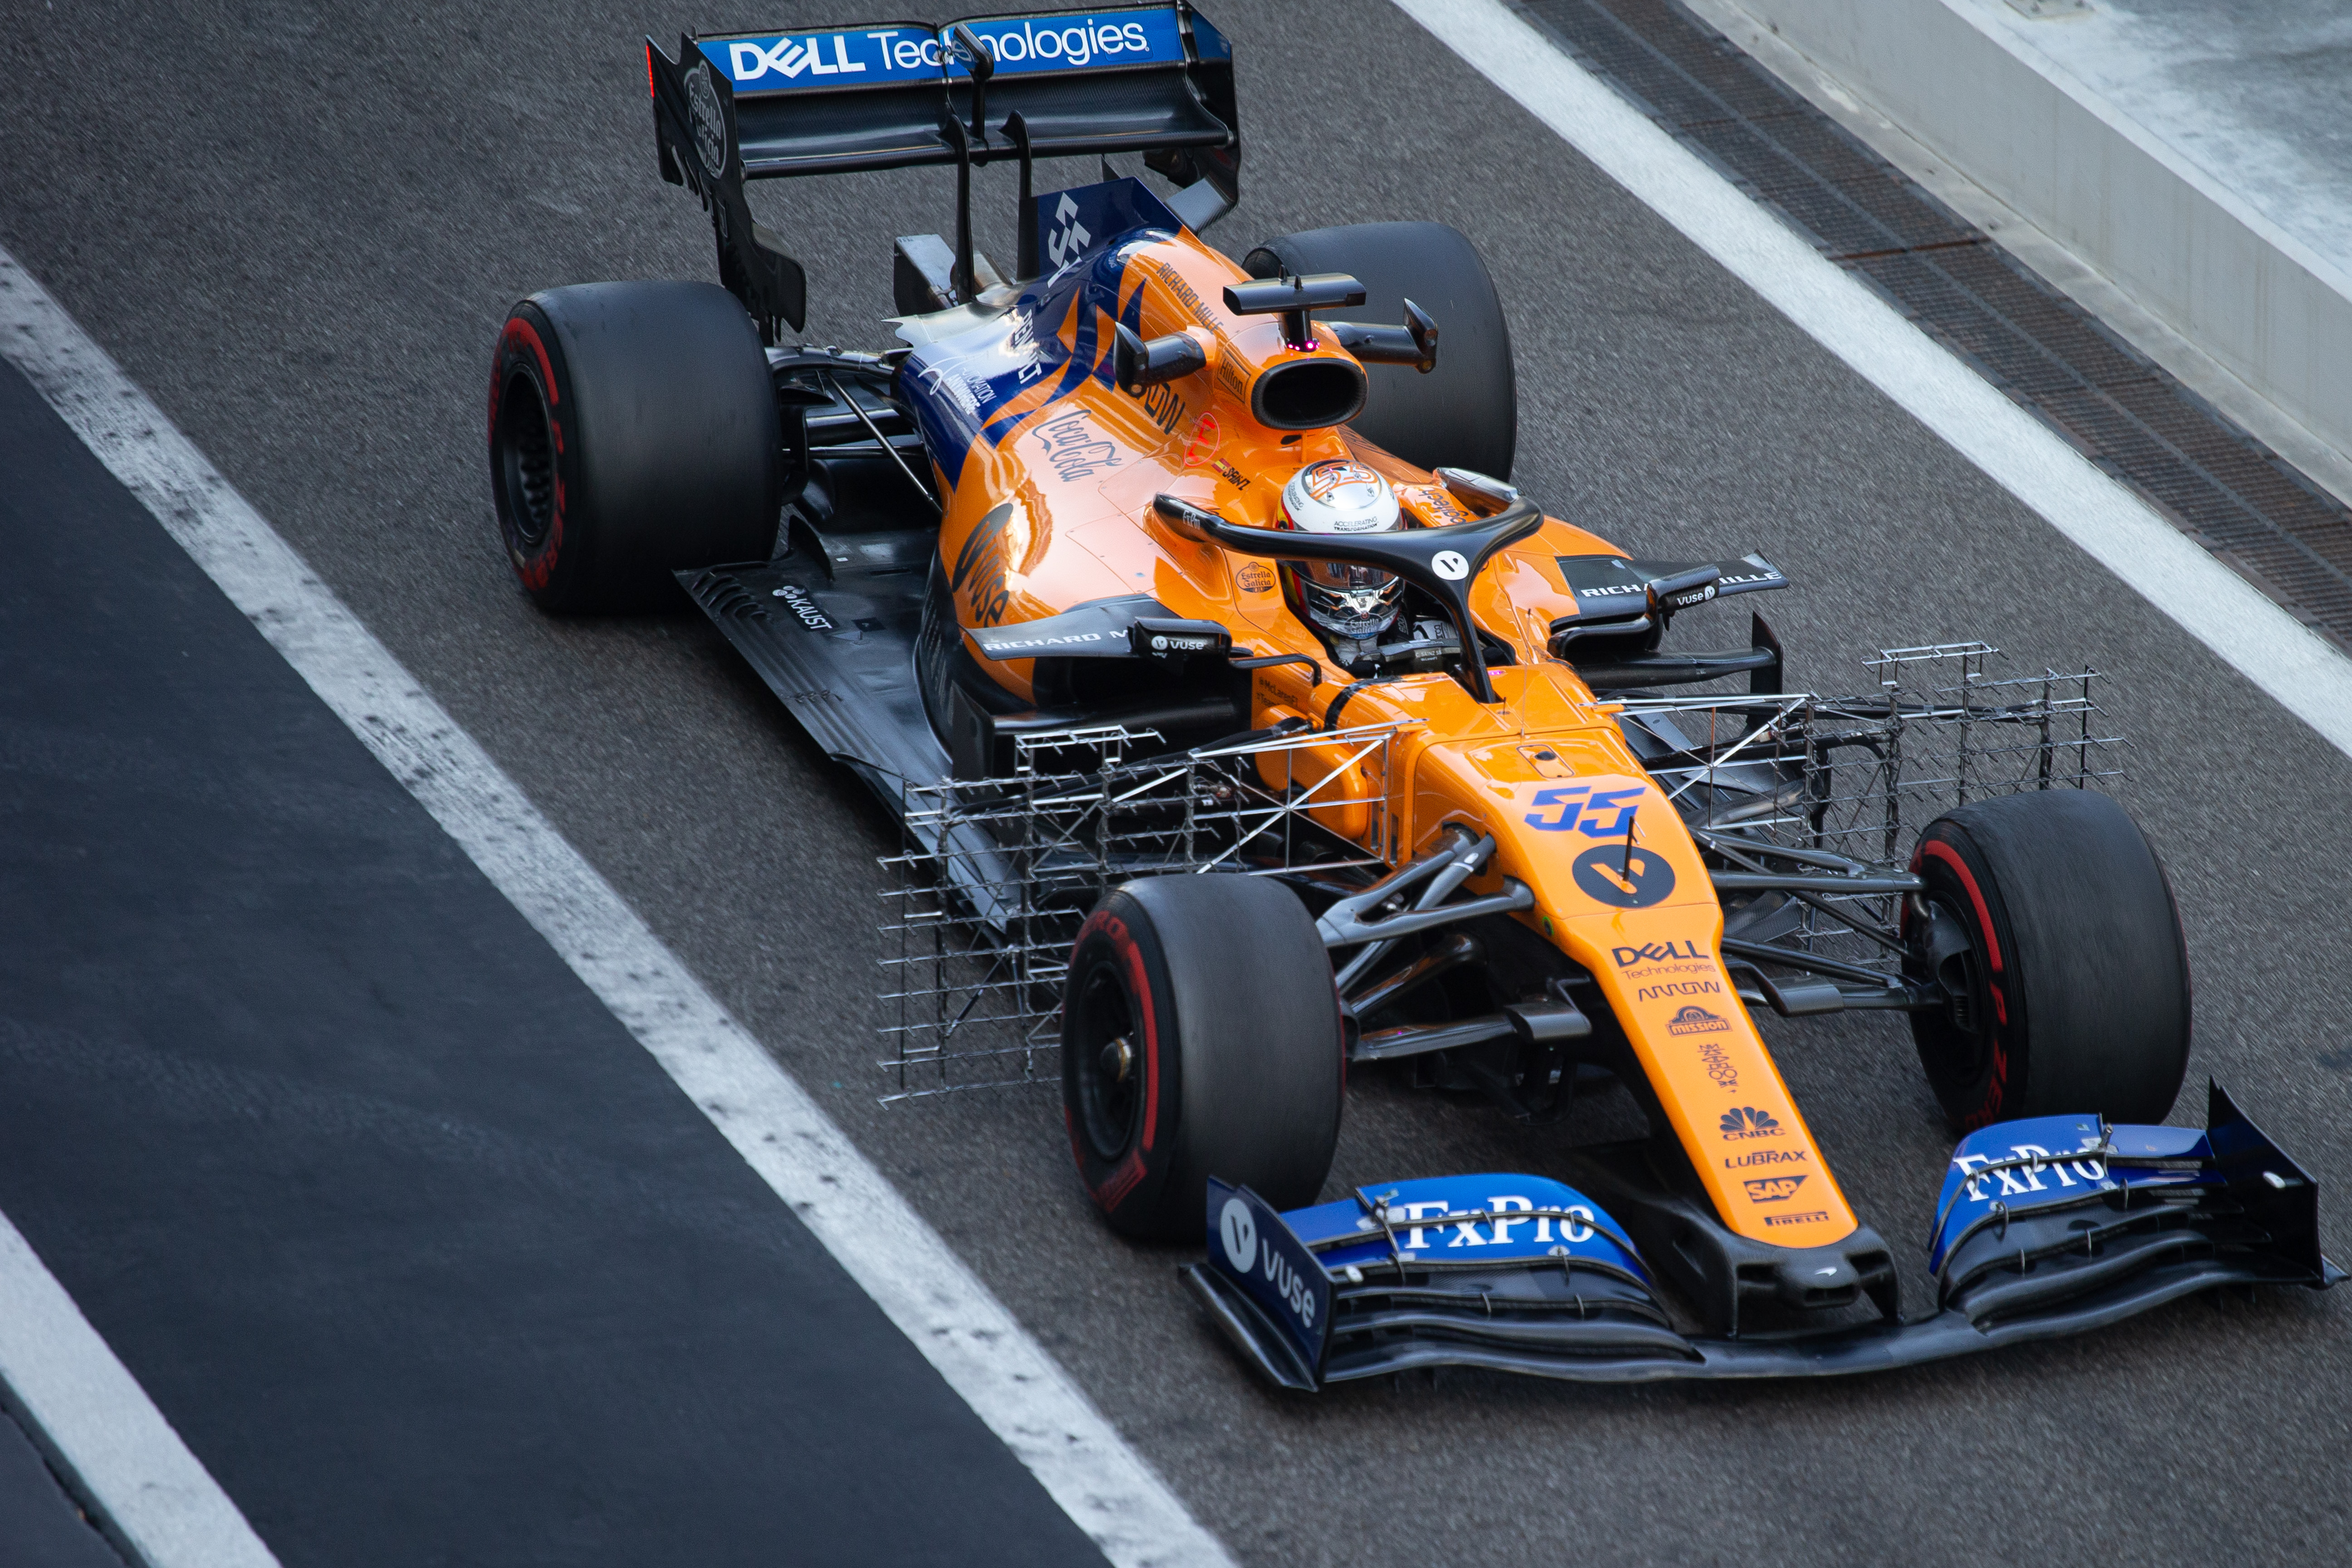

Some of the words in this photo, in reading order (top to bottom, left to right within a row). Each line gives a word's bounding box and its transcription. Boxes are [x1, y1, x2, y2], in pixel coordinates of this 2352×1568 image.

[729, 37, 866, 81] DELL
[1156, 263, 1199, 308] RICHARD
[1192, 302, 1224, 335] MILLE
[1220, 358, 1244, 396] Hilton
[1418, 489, 1469, 524] ogitech
[1241, 571, 1271, 580] Estrella
[1244, 579, 1271, 588] Galicia
[1581, 583, 1648, 598] RICH
[787, 598, 833, 629] KAUST
[1350, 618, 1379, 627] Estrella
[983, 633, 1101, 651] RICHARD
[1524, 785, 1647, 839] 55
[1612, 941, 1710, 967] DELL
[1622, 962, 1716, 980] Technologies
[1639, 981, 1720, 1002] ARROW
[1723, 1128, 1787, 1142] CNBC
[1725, 1151, 1808, 1169] LUBRAX
[1952, 1144, 2106, 1202] FxPro
[1746, 1179, 1798, 1201] SAP
[1404, 1195, 1595, 1249] FxPro
[1764, 1210, 1830, 1226] PIRELLI
